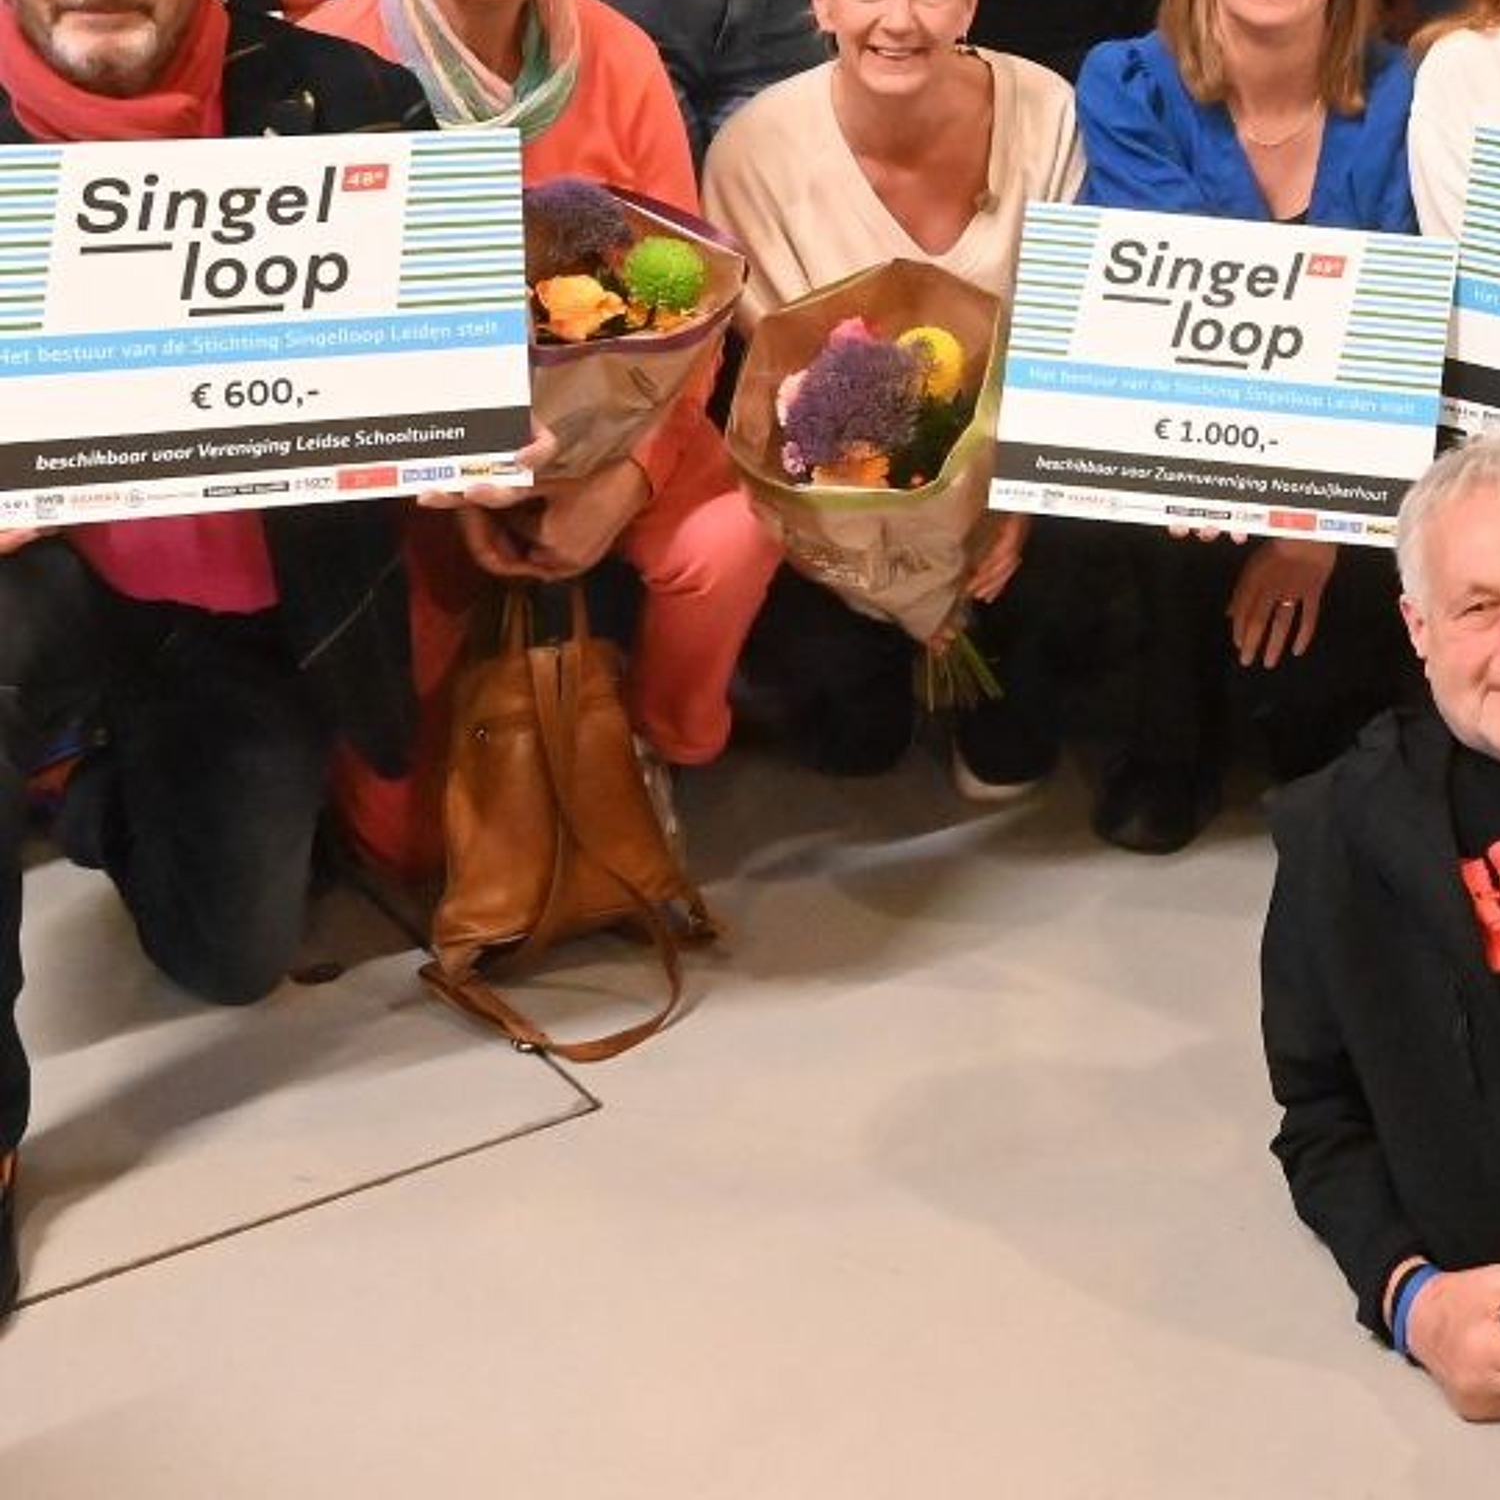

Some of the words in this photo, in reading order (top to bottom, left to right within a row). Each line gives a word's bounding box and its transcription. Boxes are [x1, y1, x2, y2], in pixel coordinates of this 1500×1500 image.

[77, 165, 336, 245] Singel
[180, 241, 349, 310] loop
[1103, 240, 1305, 307] Singel
[37, 342, 114, 361] bestuur
[121, 344, 155, 356] van
[161, 338, 185, 354] de
[194, 333, 278, 356] Stichting
[284, 326, 384, 351] Singelloop
[391, 322, 451, 340] Leiden
[457, 319, 499, 336] stelt
[1171, 302, 1303, 371] loop
[190, 382, 213, 411] €
[224, 375, 320, 413] 600,-
[35, 447, 148, 472] beschikbaar
[151, 447, 193, 463] voor
[197, 436, 291, 462] Vereniging
[295, 431, 351, 452] Leidse
[354, 423, 465, 447] Schooltuinen
[1152, 416, 1172, 440] €
[1179, 419, 1280, 454] 1.000,-
[1035, 455, 1118, 475] beschikbaar
[1121, 466, 1153, 479] voor
[1153, 466, 1268, 493] Zwemvereniging
[1270, 478, 1388, 504] Noordwijkerhout
